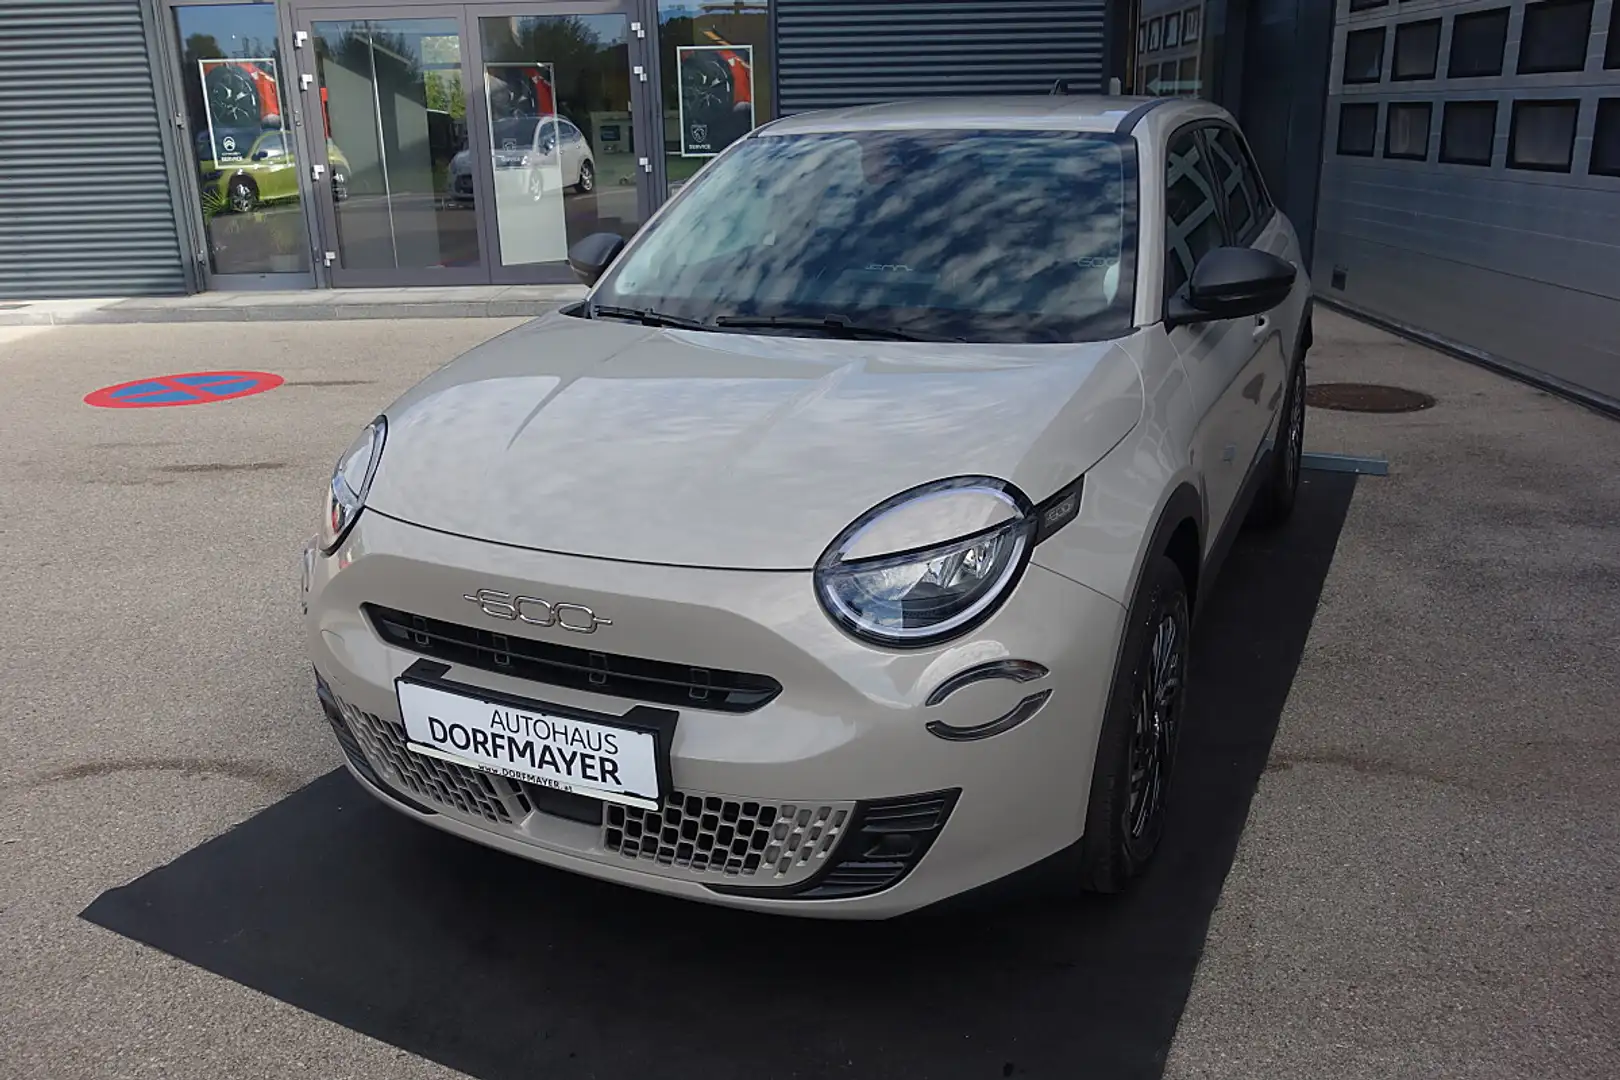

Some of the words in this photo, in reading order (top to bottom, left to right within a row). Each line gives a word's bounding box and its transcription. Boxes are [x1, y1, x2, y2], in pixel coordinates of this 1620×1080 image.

[463, 588, 613, 634] 600
[428, 716, 622, 786] DORFMAYER
[490, 709, 618, 755] AUTOHAUS
